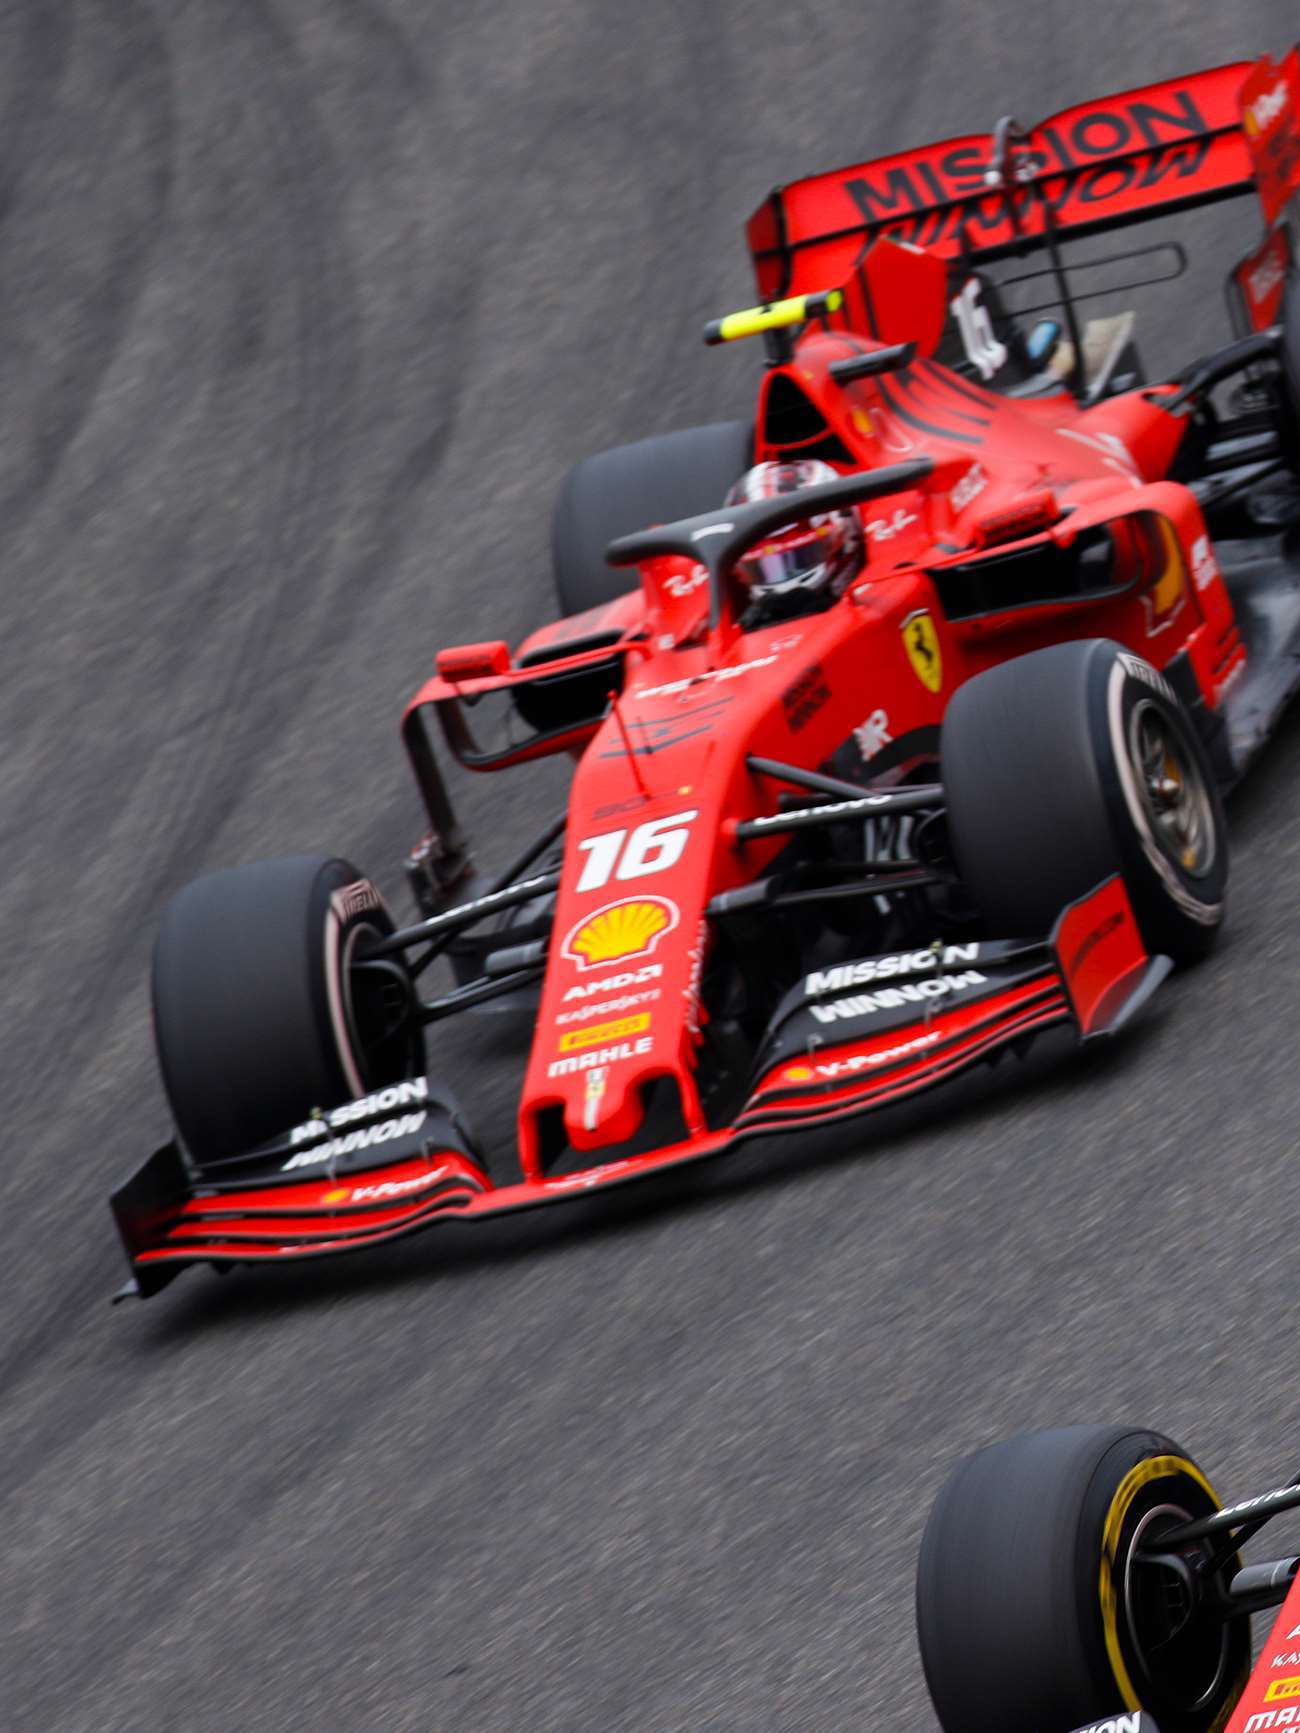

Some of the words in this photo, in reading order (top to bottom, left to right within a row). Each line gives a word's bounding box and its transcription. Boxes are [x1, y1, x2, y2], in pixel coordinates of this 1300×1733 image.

[844, 92, 1206, 223] MISION
[575, 808, 699, 894] 16
[809, 970, 988, 1023] WINNOW
[547, 1036, 655, 1078] MAHLE
[815, 1031, 942, 1076] V-Power
[290, 1076, 428, 1144] MSSION
